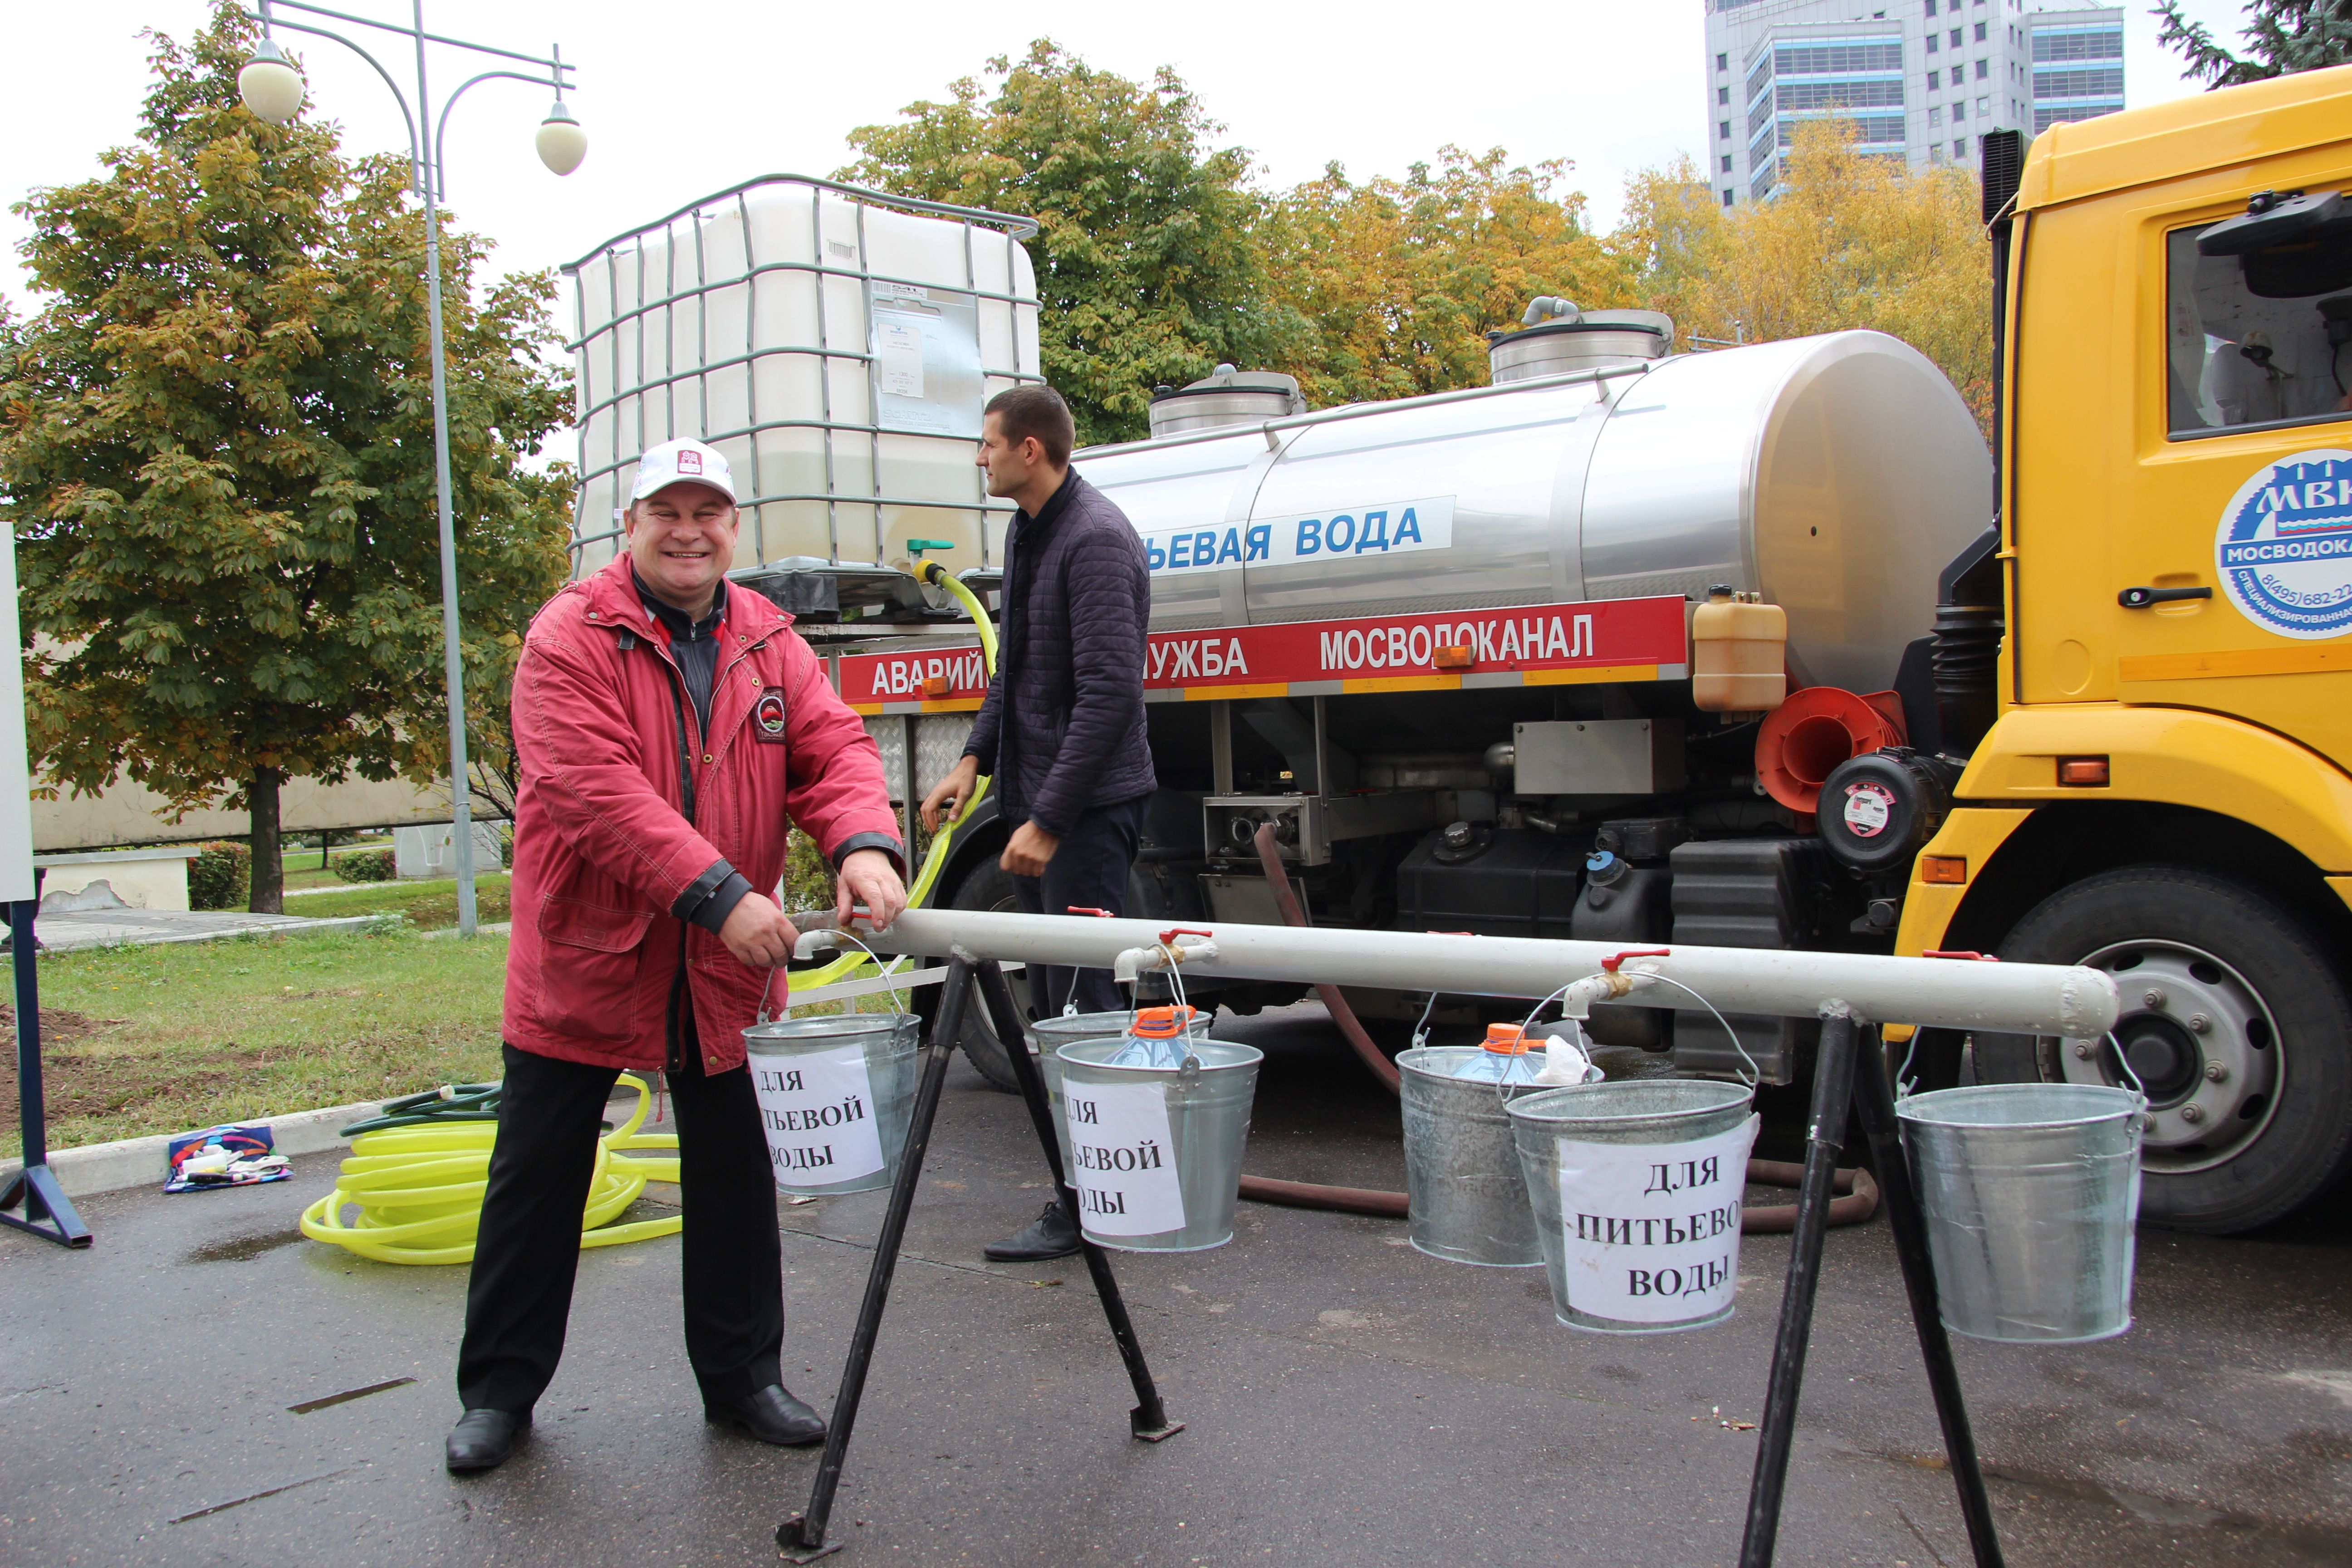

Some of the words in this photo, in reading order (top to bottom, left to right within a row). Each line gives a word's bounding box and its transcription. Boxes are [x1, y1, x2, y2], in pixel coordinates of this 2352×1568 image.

[1142, 524, 1272, 570] ЬЕВАЯ
[1295, 507, 1422, 556] ВОДА
[2227, 539, 2352, 563] МОСВОДОК
[1320, 614, 1593, 670] МОСВОДОКАНАЛ
[872, 650, 990, 696] АВАРИЙ
[760, 1070, 805, 1094] ДЛЯ
[769, 1144, 836, 1172] ВОДЫ
[1644, 1155, 1720, 1198] ДЛЯ
[1576, 1193, 1742, 1245] ПИТЬЕВО
[1627, 1254, 1730, 1300] ВОДЫ
